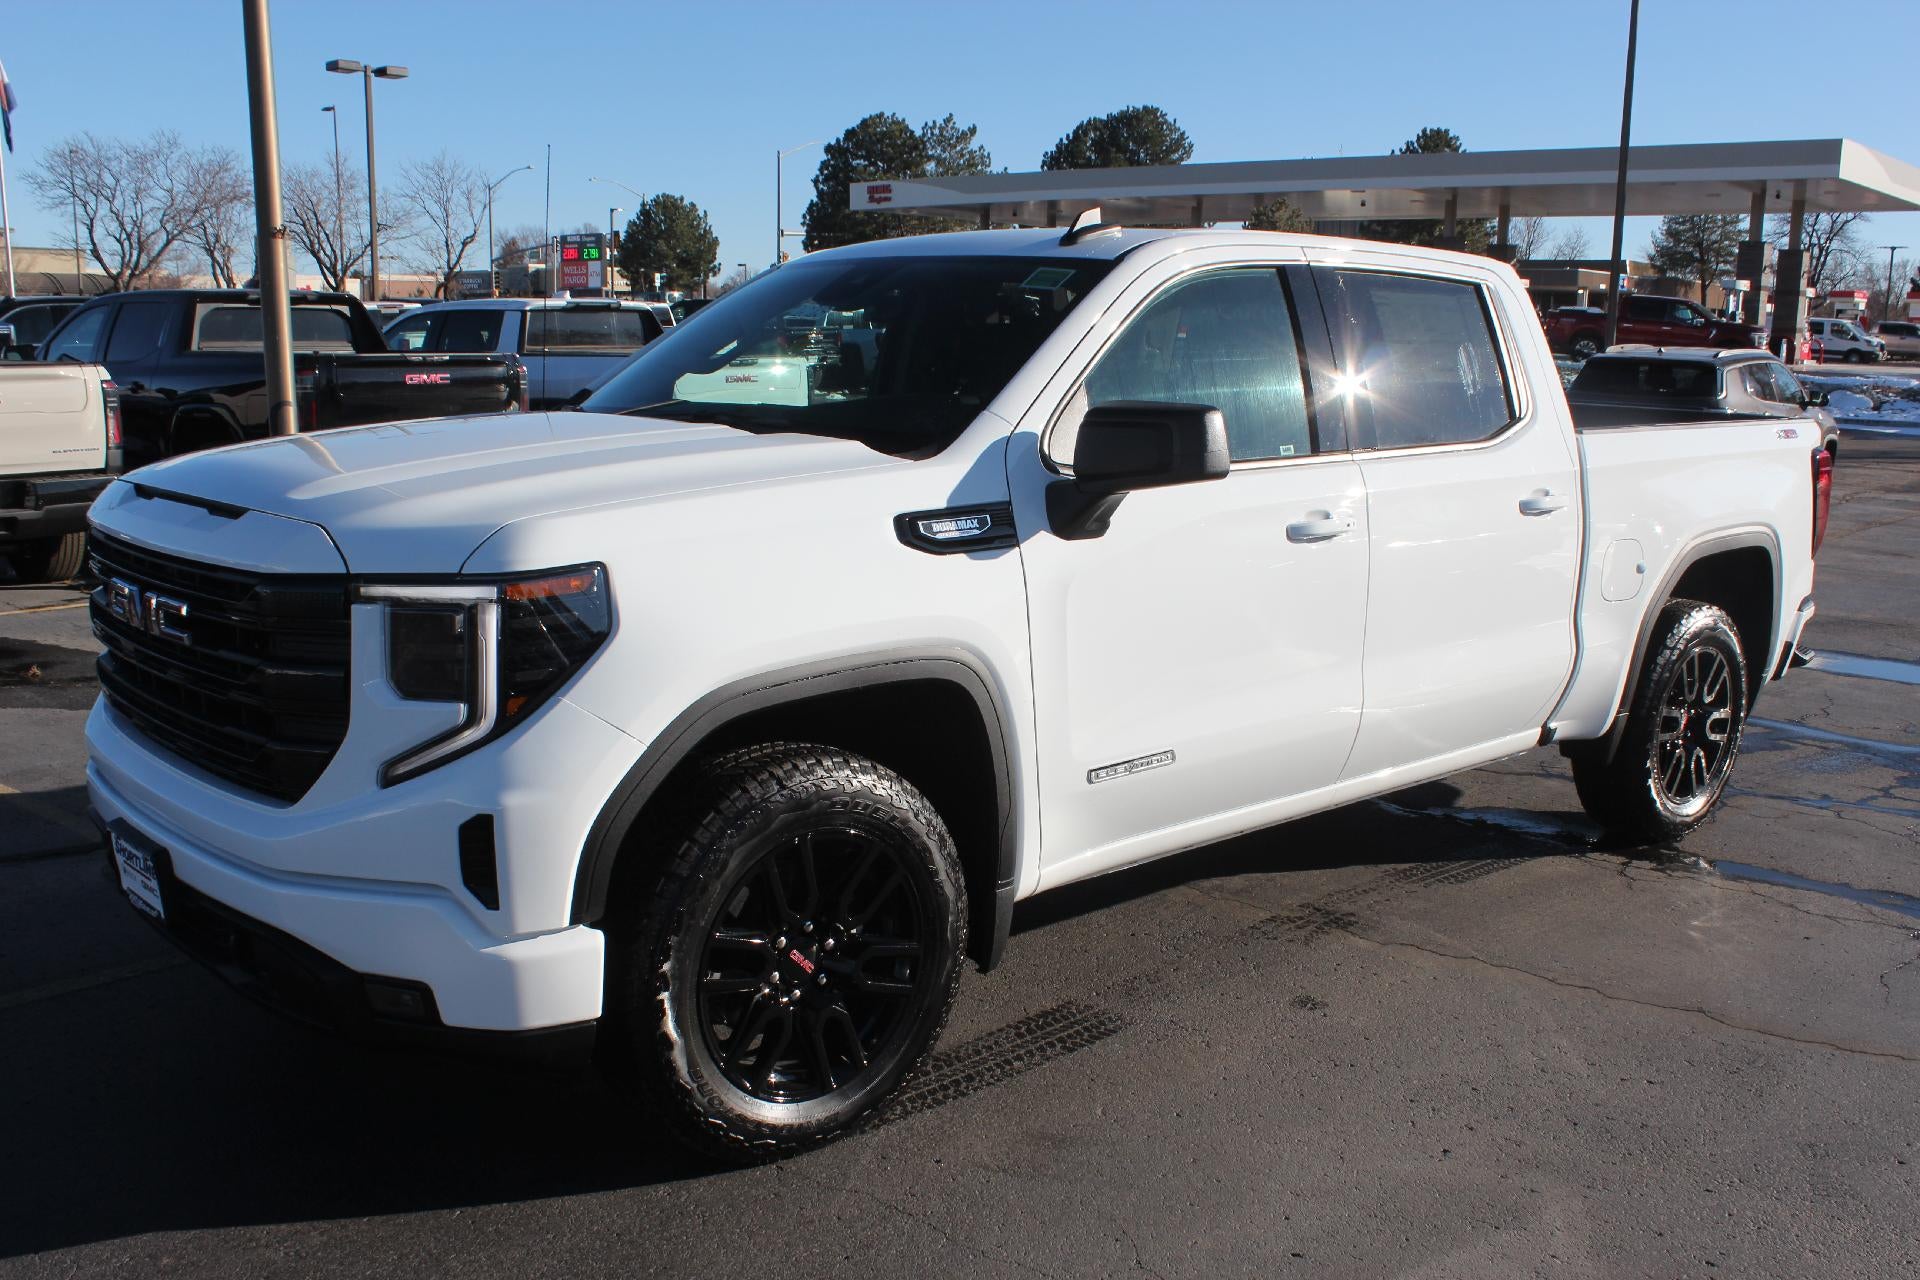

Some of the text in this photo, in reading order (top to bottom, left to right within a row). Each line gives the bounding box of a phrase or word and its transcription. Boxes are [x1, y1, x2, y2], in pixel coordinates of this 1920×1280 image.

[564, 266, 587, 274] WELLS
[564, 276, 587, 284] FARGO
[405, 373, 451, 385] GMC
[108, 577, 191, 646] GMC
[790, 949, 815, 973] GMC
